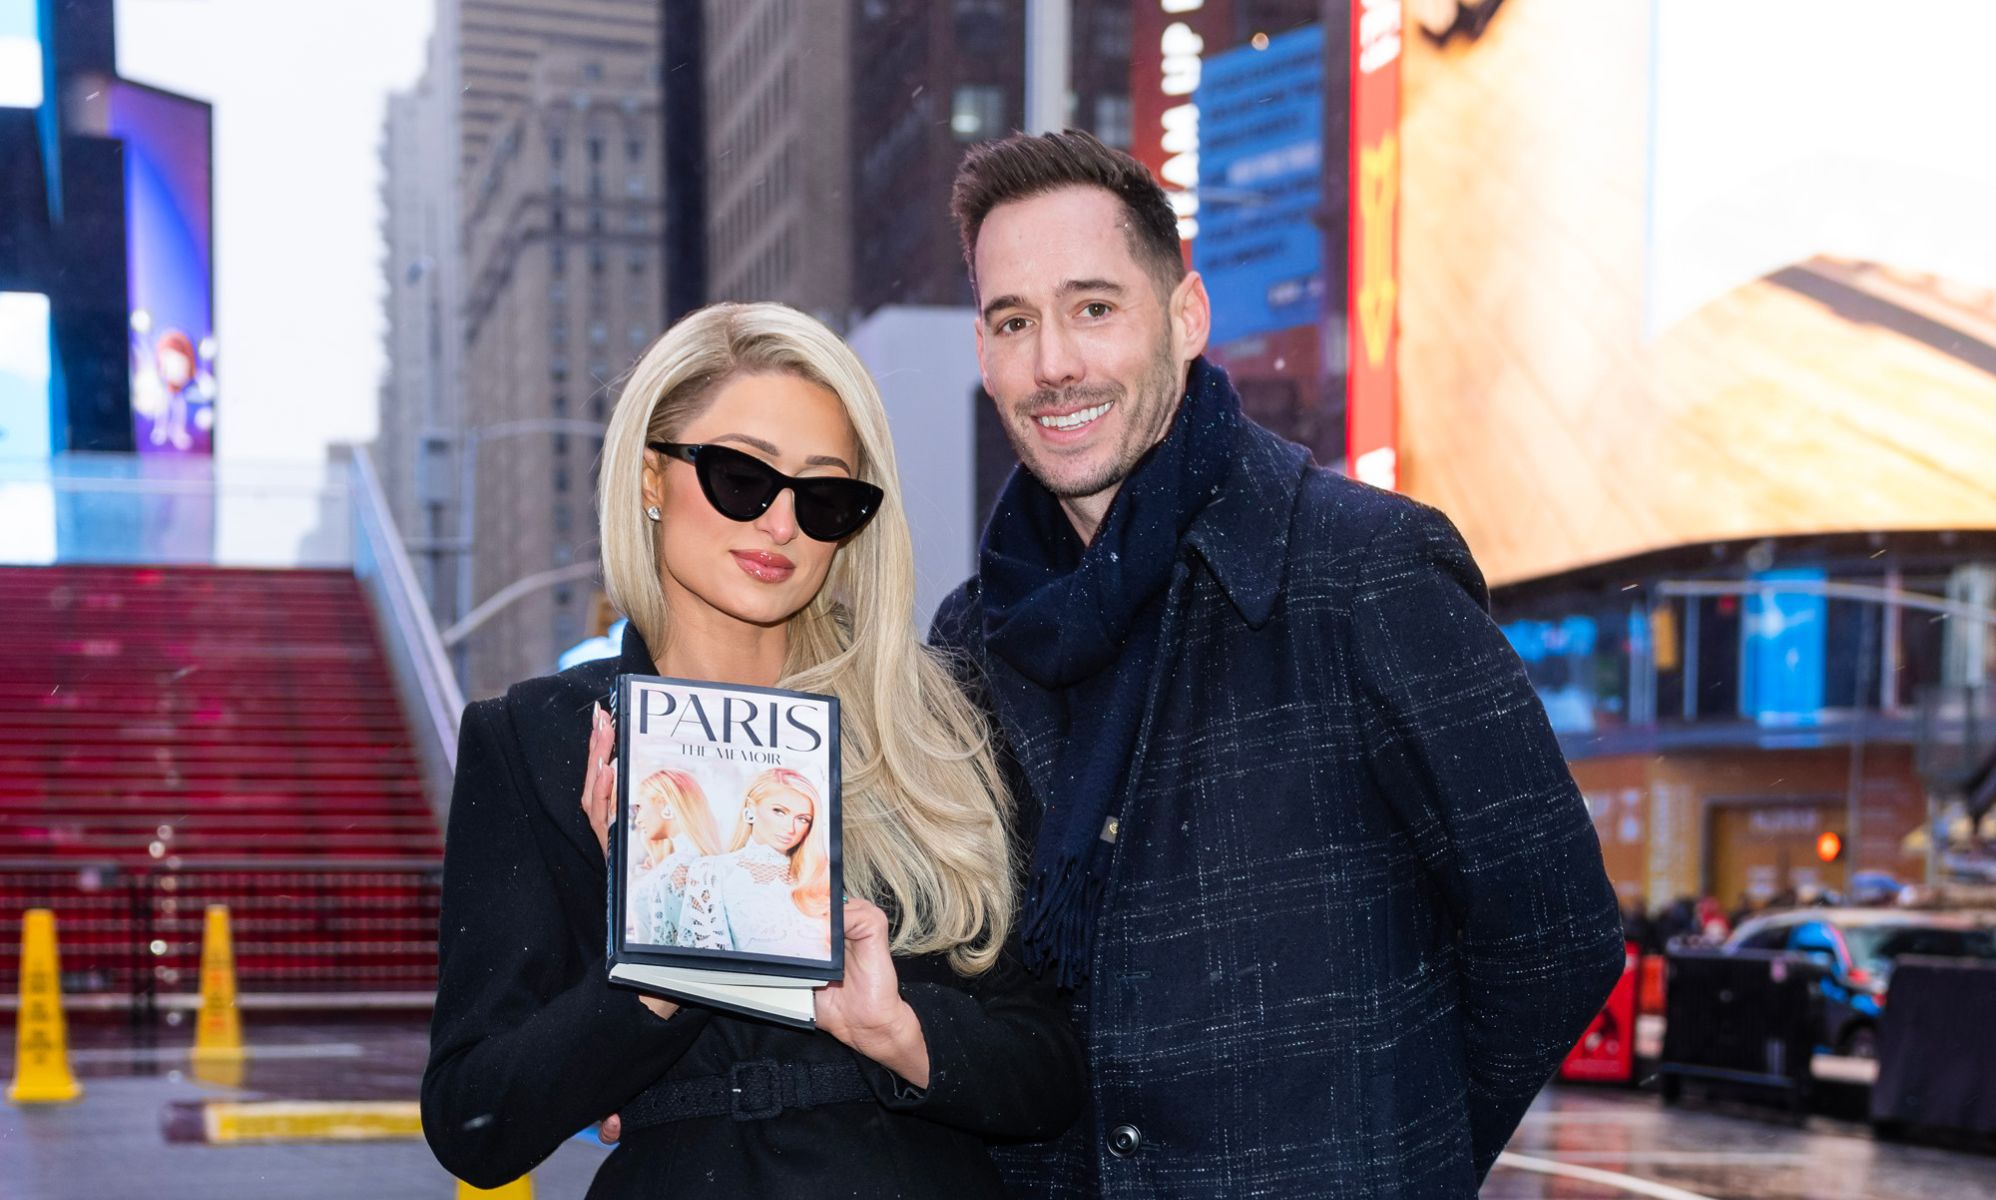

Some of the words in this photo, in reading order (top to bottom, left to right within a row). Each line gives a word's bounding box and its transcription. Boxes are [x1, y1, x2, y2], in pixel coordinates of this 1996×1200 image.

[639, 688, 821, 752] PARIS
[681, 743, 707, 758] THE
[716, 747, 781, 765] MEMOIR
